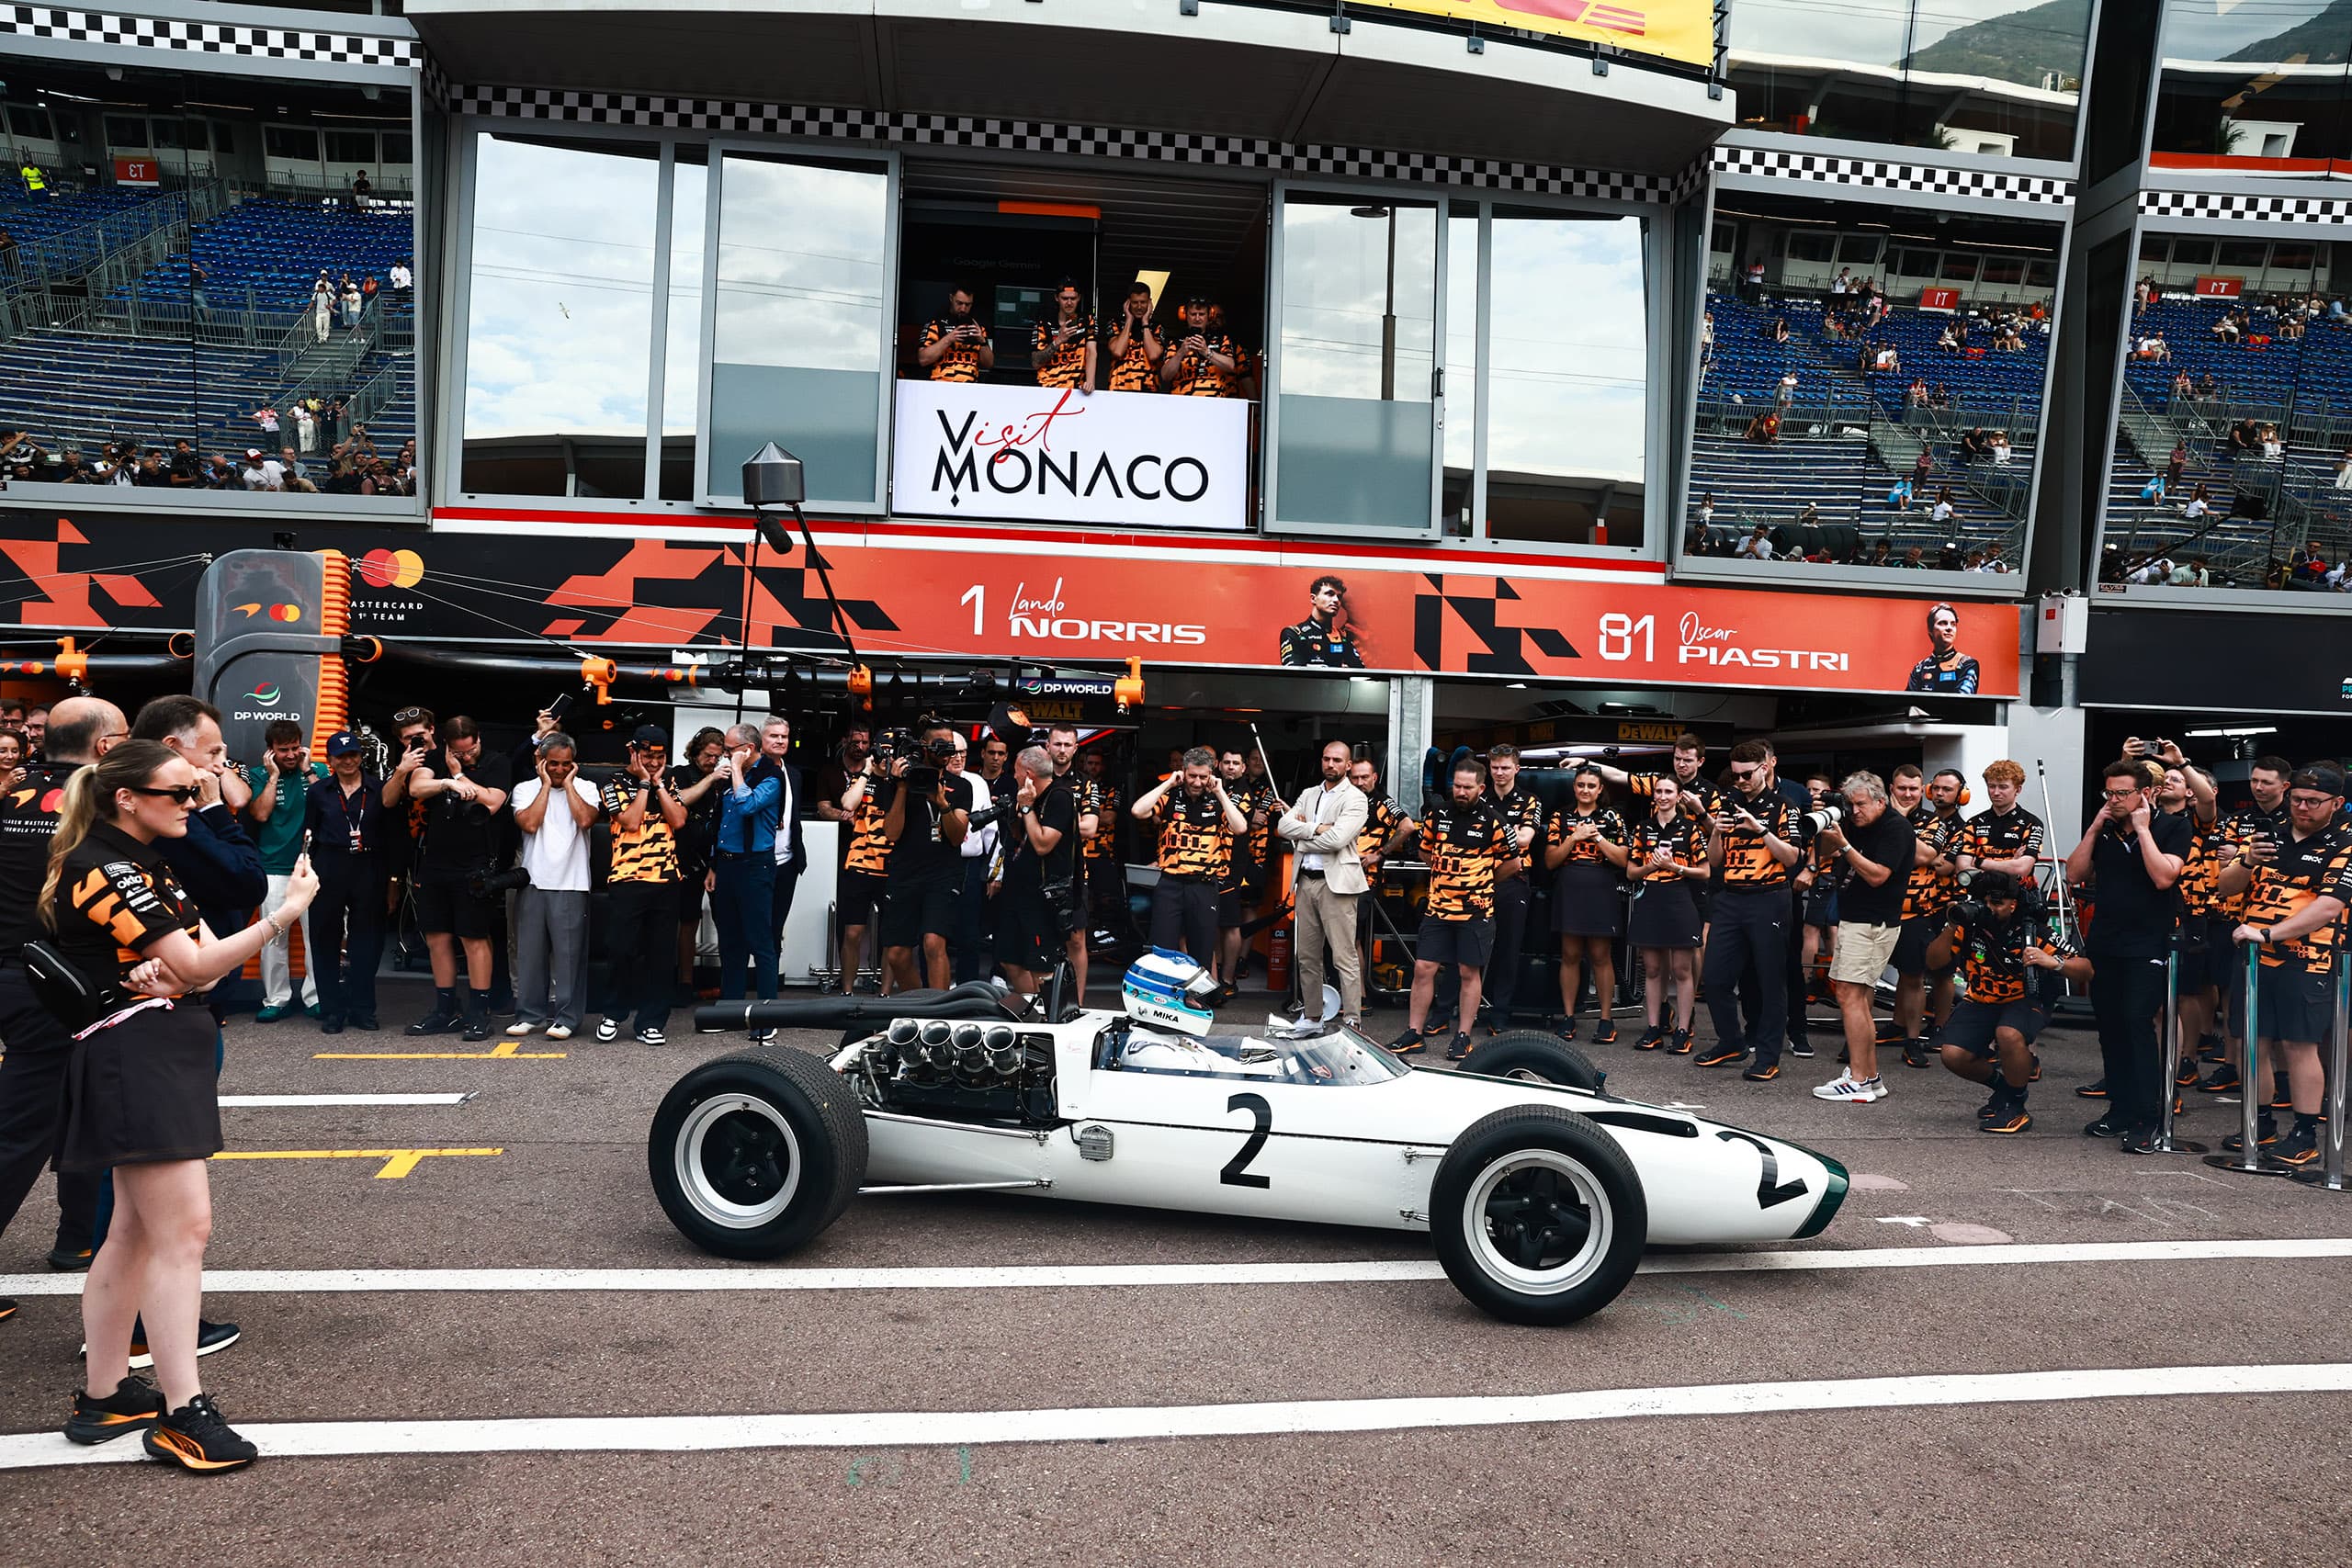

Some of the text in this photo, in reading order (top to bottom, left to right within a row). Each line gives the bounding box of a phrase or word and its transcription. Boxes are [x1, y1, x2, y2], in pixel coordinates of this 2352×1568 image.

[936, 389, 1085, 464] Visit
[932, 445, 1209, 503] MONACO
[346, 601, 424, 610] ASTERCARD
[961, 584, 985, 636] 1
[1008, 576, 1066, 620] Lando
[372, 613, 405, 621] TEAM
[1011, 617, 1206, 645] NORRIS
[1679, 611, 1738, 646] Oscar
[1599, 613, 1654, 662] 81
[1678, 645, 1849, 671] PIASTRI
[1044, 683, 1112, 694] DP WORLD
[234, 712, 300, 721] DP WORLD
[117, 874, 143, 889] okta
[1153, 1010, 1179, 1023] MIKA
[1220, 1092, 1272, 1190] 2
[1715, 1130, 1809, 1210] 2
